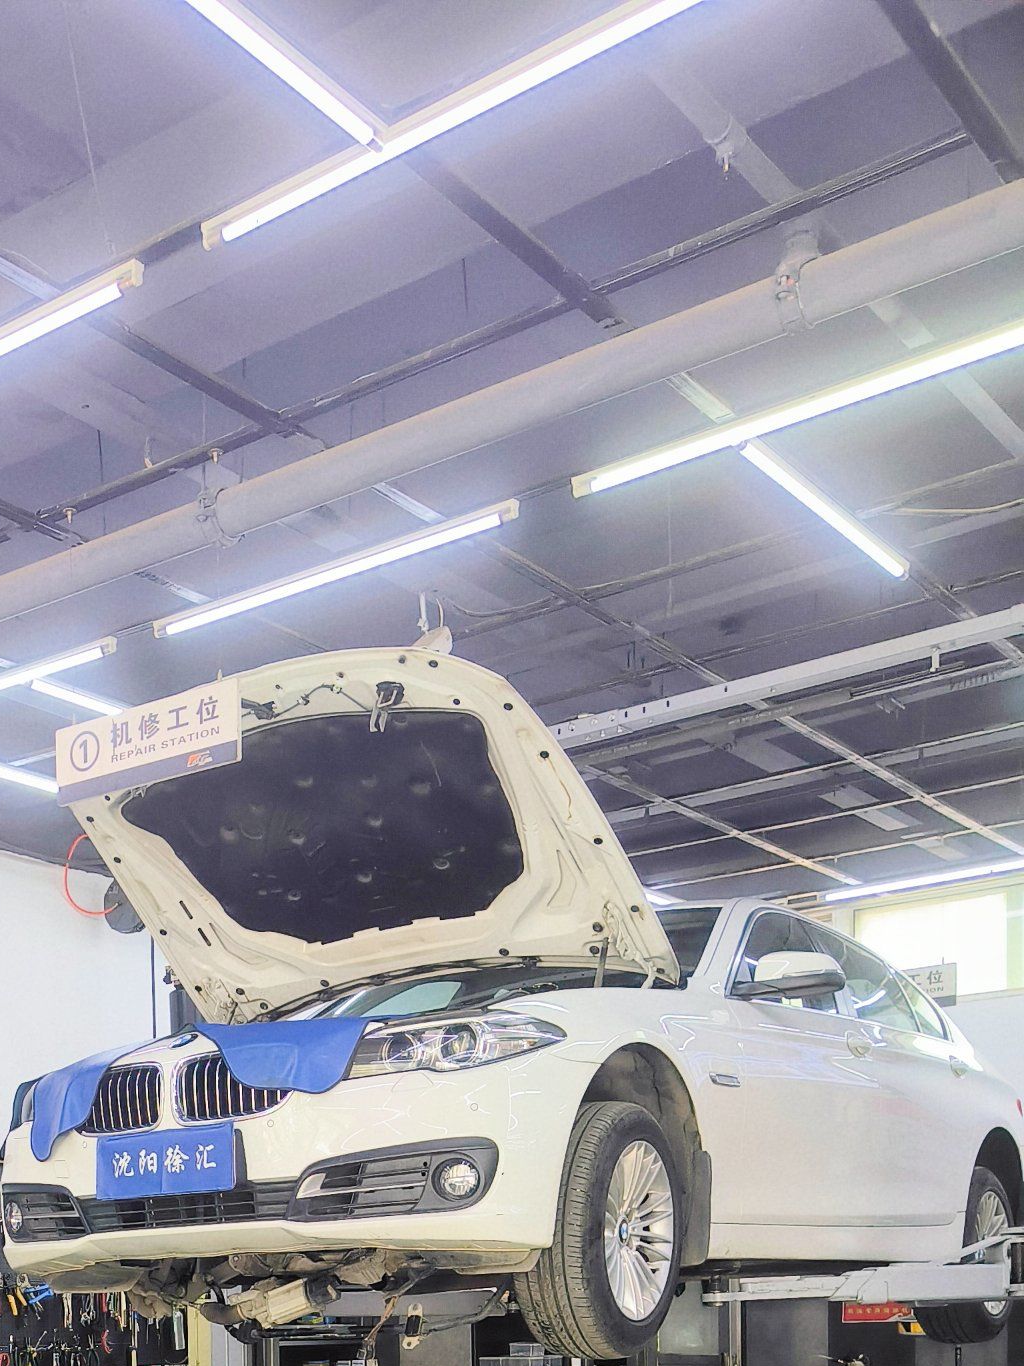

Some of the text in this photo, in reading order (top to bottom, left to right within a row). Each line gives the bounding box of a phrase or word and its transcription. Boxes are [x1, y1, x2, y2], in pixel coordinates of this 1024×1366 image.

[110, 695, 220, 749] 机修工位
[111, 725, 220, 764] REPAIR STATION
[112, 1143, 217, 1179] 沈阳徐汇
